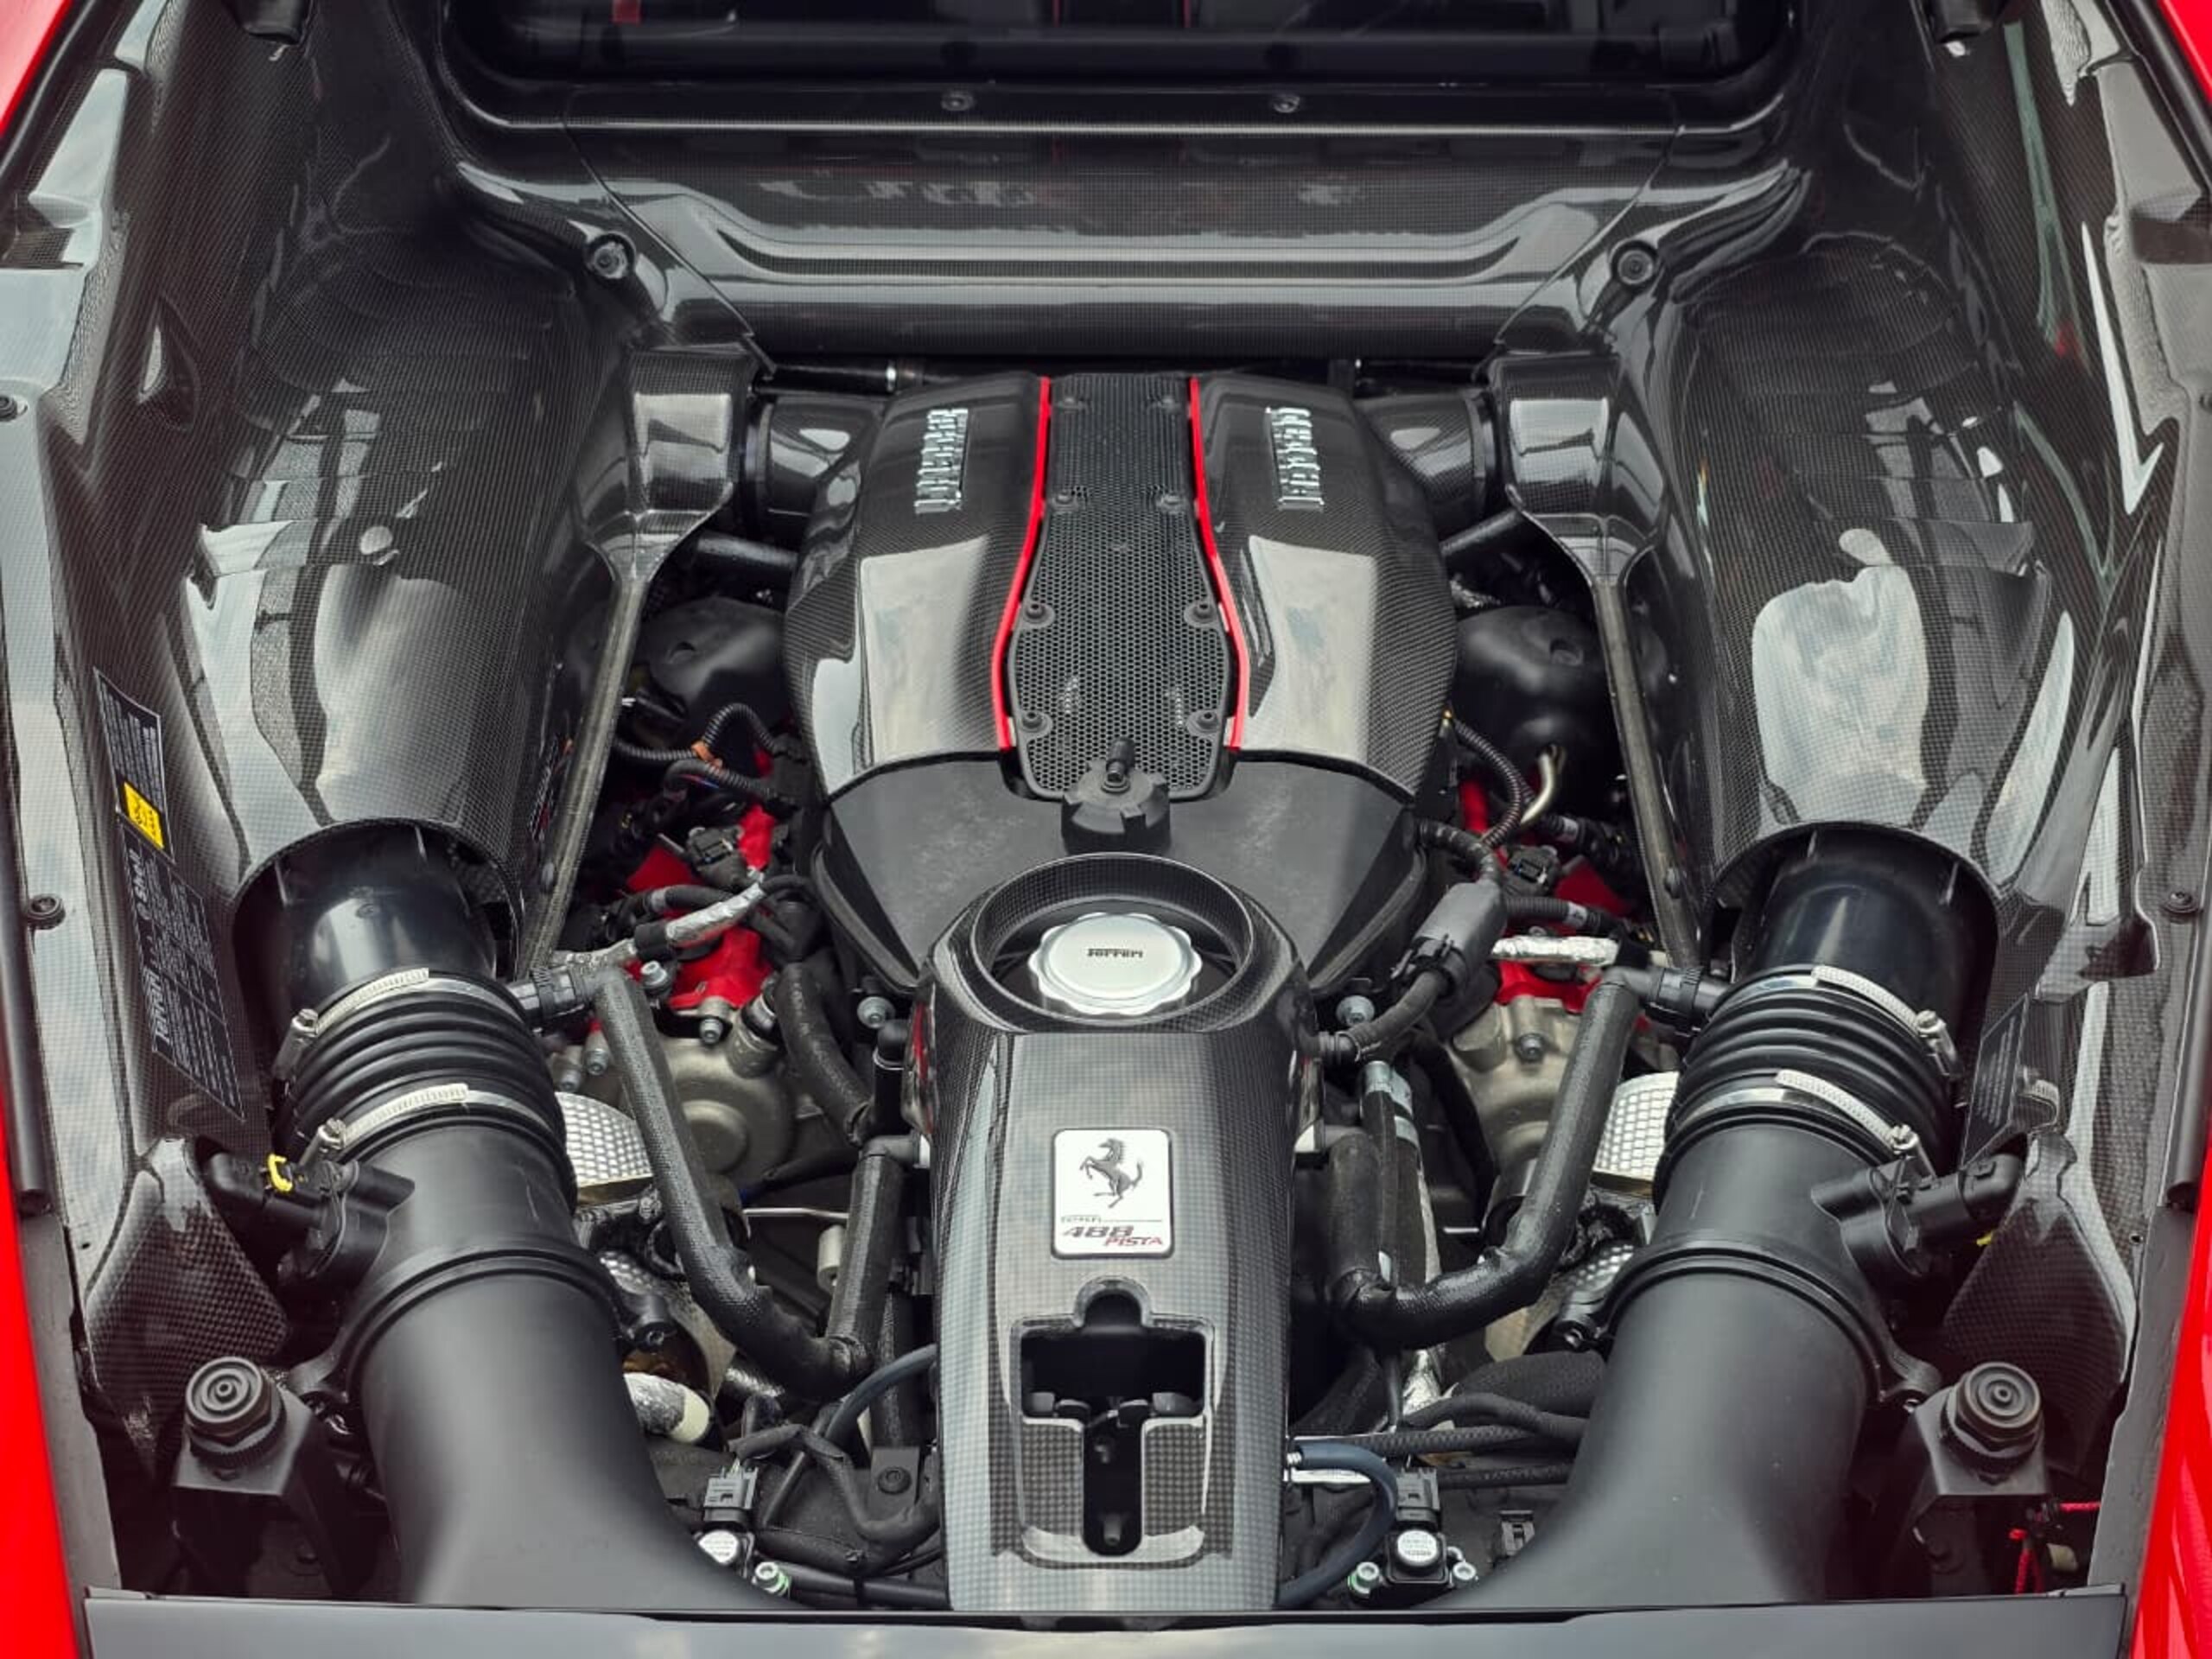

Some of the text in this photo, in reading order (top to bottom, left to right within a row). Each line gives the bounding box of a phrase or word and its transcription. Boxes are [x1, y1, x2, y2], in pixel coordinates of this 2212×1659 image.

[1087, 948, 1143, 958] Ferrari
[141, 965, 171, 1045] Ferrari
[1062, 1225, 1134, 1238] 488
[1103, 1236, 1163, 1247] PISTA
